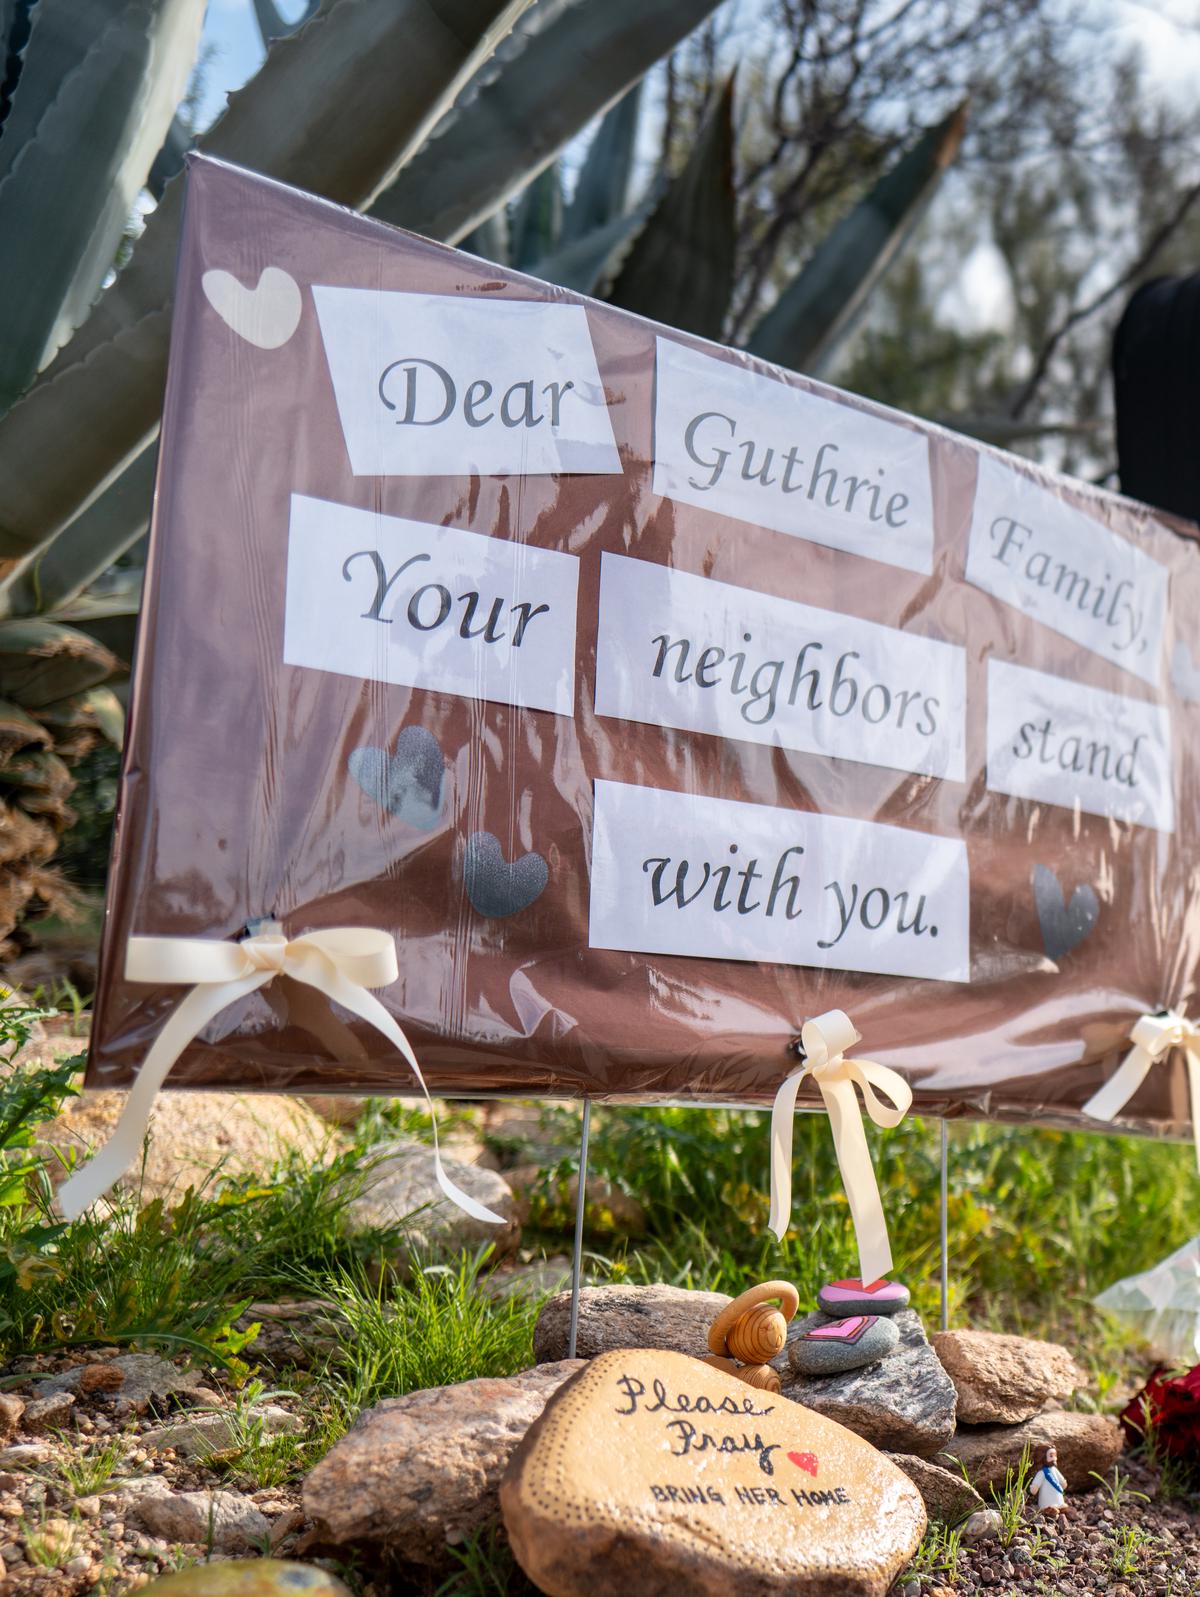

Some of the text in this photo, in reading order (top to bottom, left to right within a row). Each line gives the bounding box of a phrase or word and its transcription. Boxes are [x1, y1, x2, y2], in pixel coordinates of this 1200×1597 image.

[379, 357, 1148, 655] Dear Guthrie Family,
[341, 549, 1148, 789] Your neighbors stand
[642, 843, 940, 949] with you.
[615, 1374, 775, 1415] Please
[666, 1419, 781, 1476] Pray
[650, 1484, 850, 1508] BRING HER HOME
